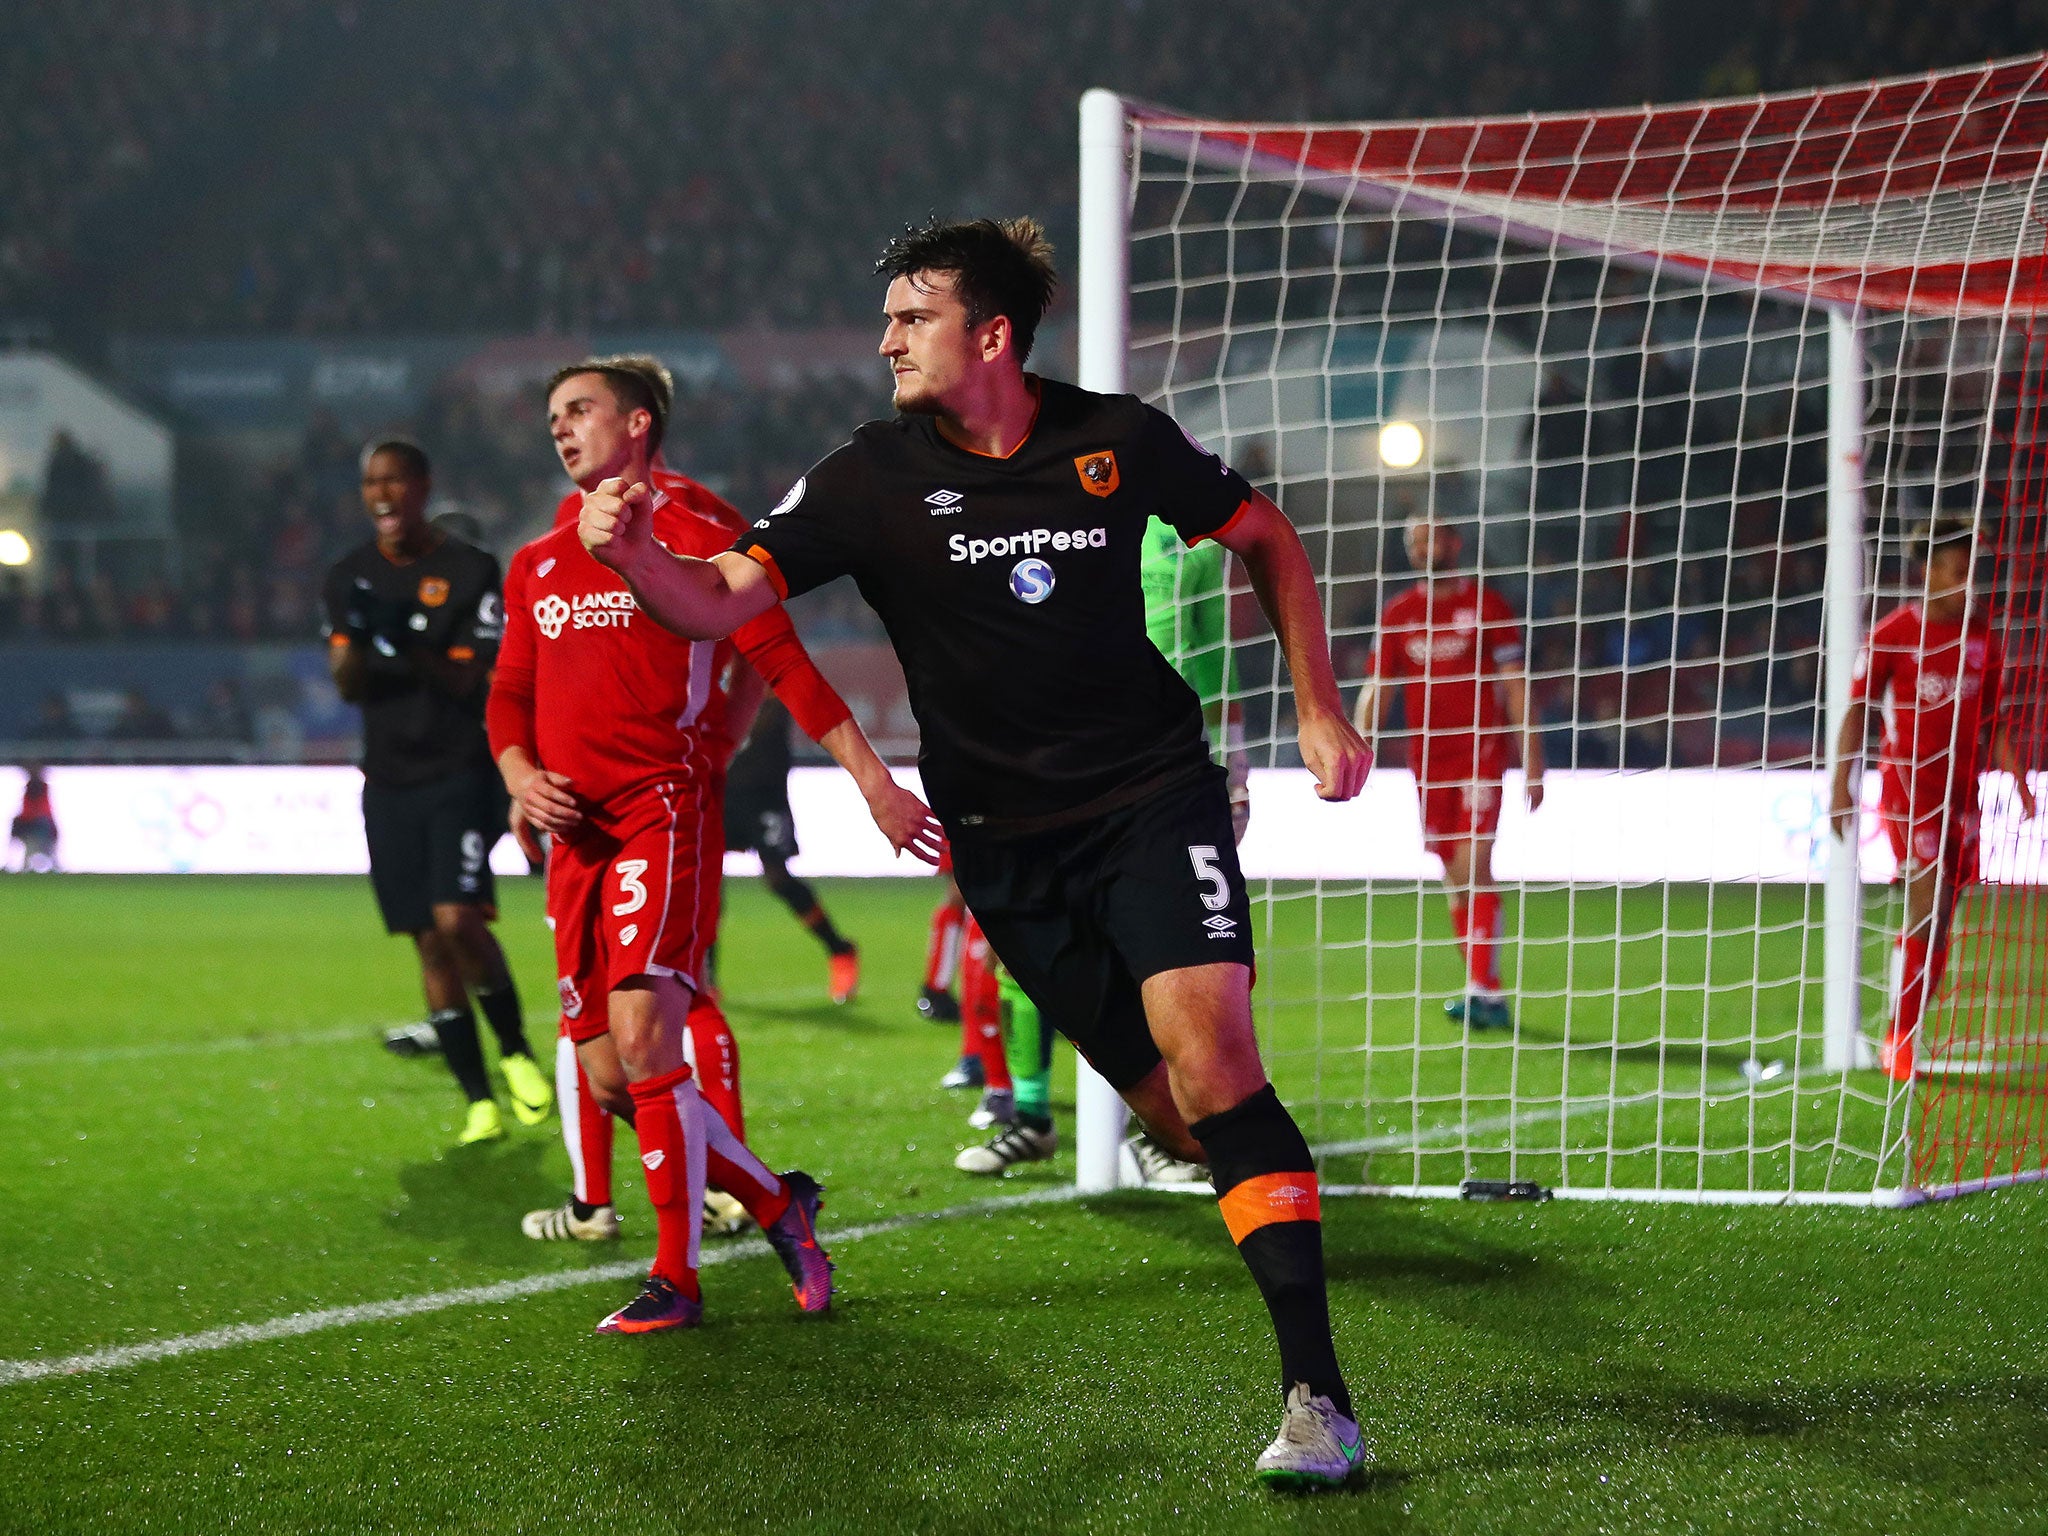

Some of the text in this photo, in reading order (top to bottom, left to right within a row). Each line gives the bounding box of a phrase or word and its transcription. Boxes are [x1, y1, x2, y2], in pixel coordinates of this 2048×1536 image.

[931, 506, 963, 516] umbro
[948, 527, 1106, 564] SportPesa
[572, 611, 633, 629] SCOTT
[461, 830, 485, 872] 9
[612, 859, 648, 917] 3
[1188, 845, 1230, 911] 5
[1207, 930, 1237, 939] umbro
[716, 1033, 734, 1091] CITY
